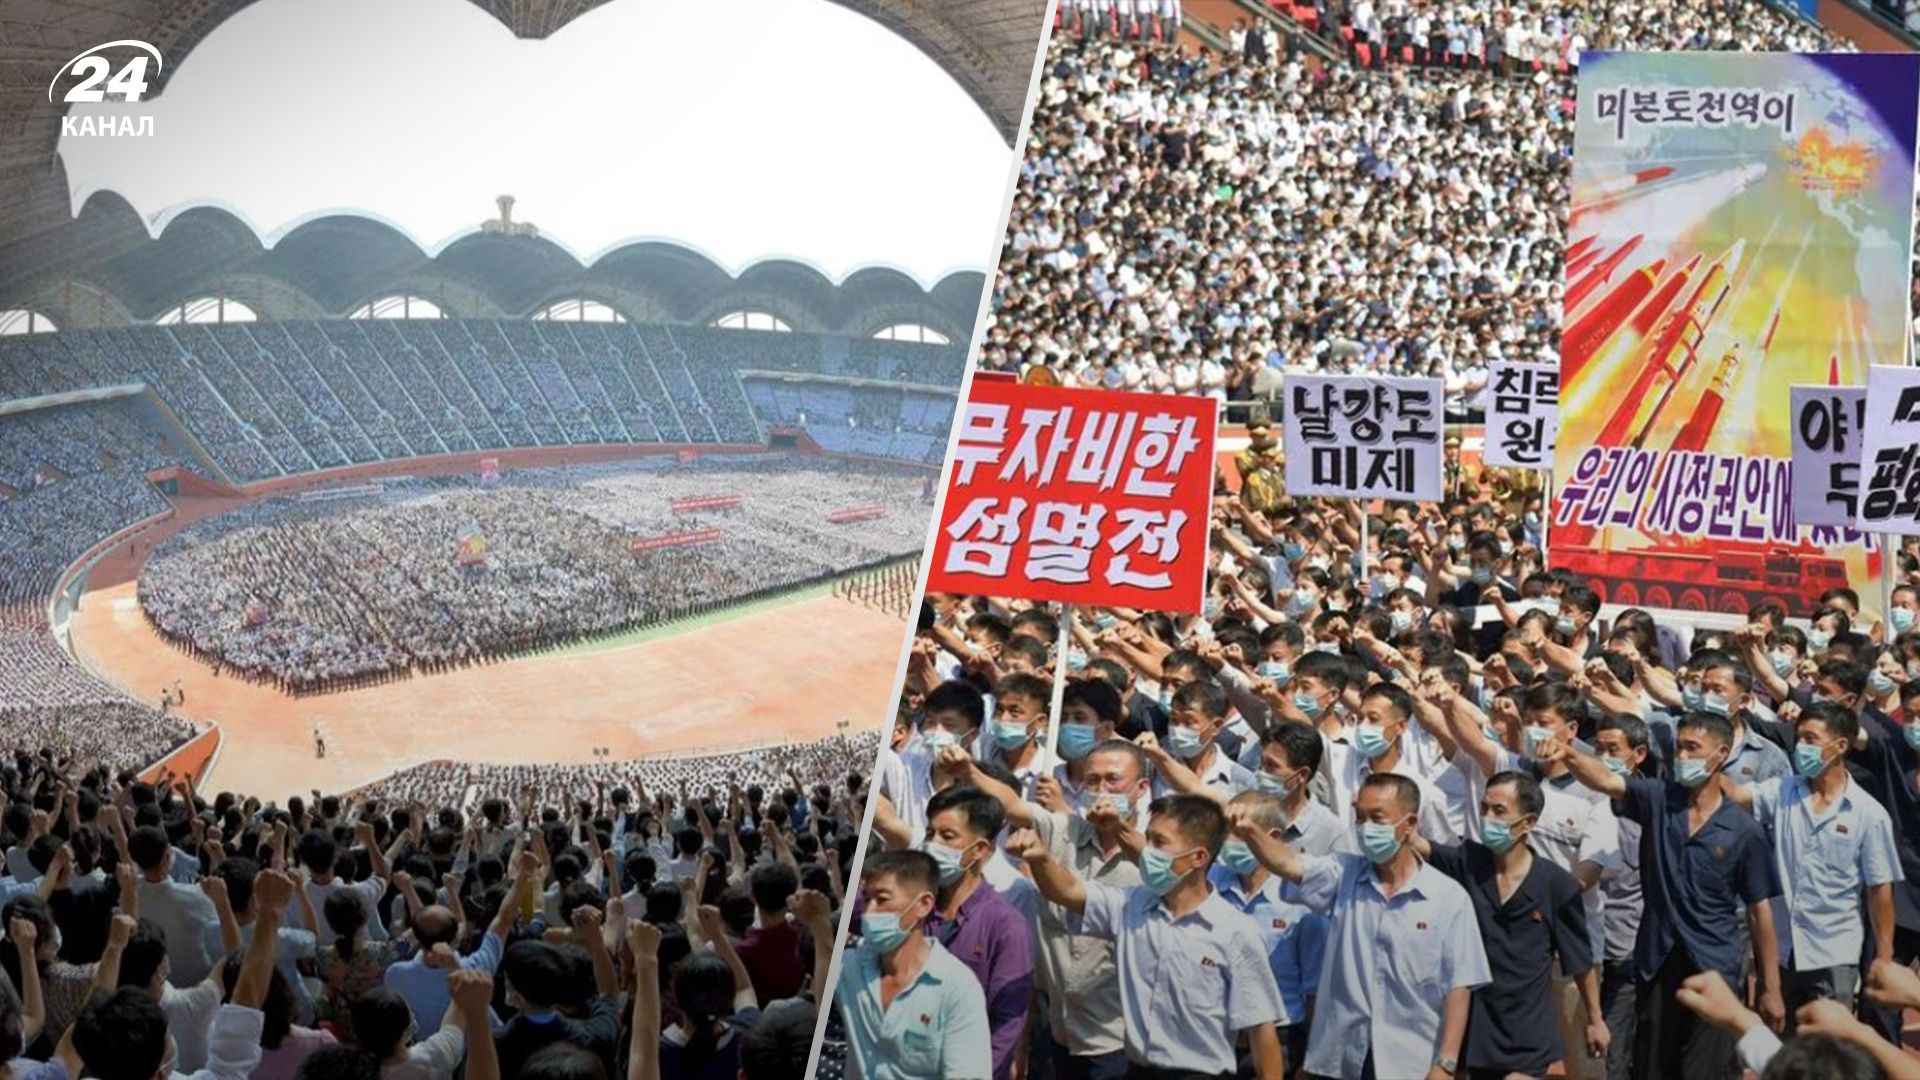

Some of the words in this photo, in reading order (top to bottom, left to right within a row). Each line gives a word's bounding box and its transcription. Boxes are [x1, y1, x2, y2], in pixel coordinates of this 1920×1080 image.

[1598, 88, 1795, 139] 미본토전역이
[1293, 384, 1438, 444] 날강도
[1501, 416, 1556, 463] 원
[1800, 397, 1867, 452] 야
[954, 402, 1201, 498] 무자비한
[1312, 446, 1415, 493] 미제
[1559, 448, 1658, 528] 우리의
[944, 497, 1188, 589] 섬멸전
